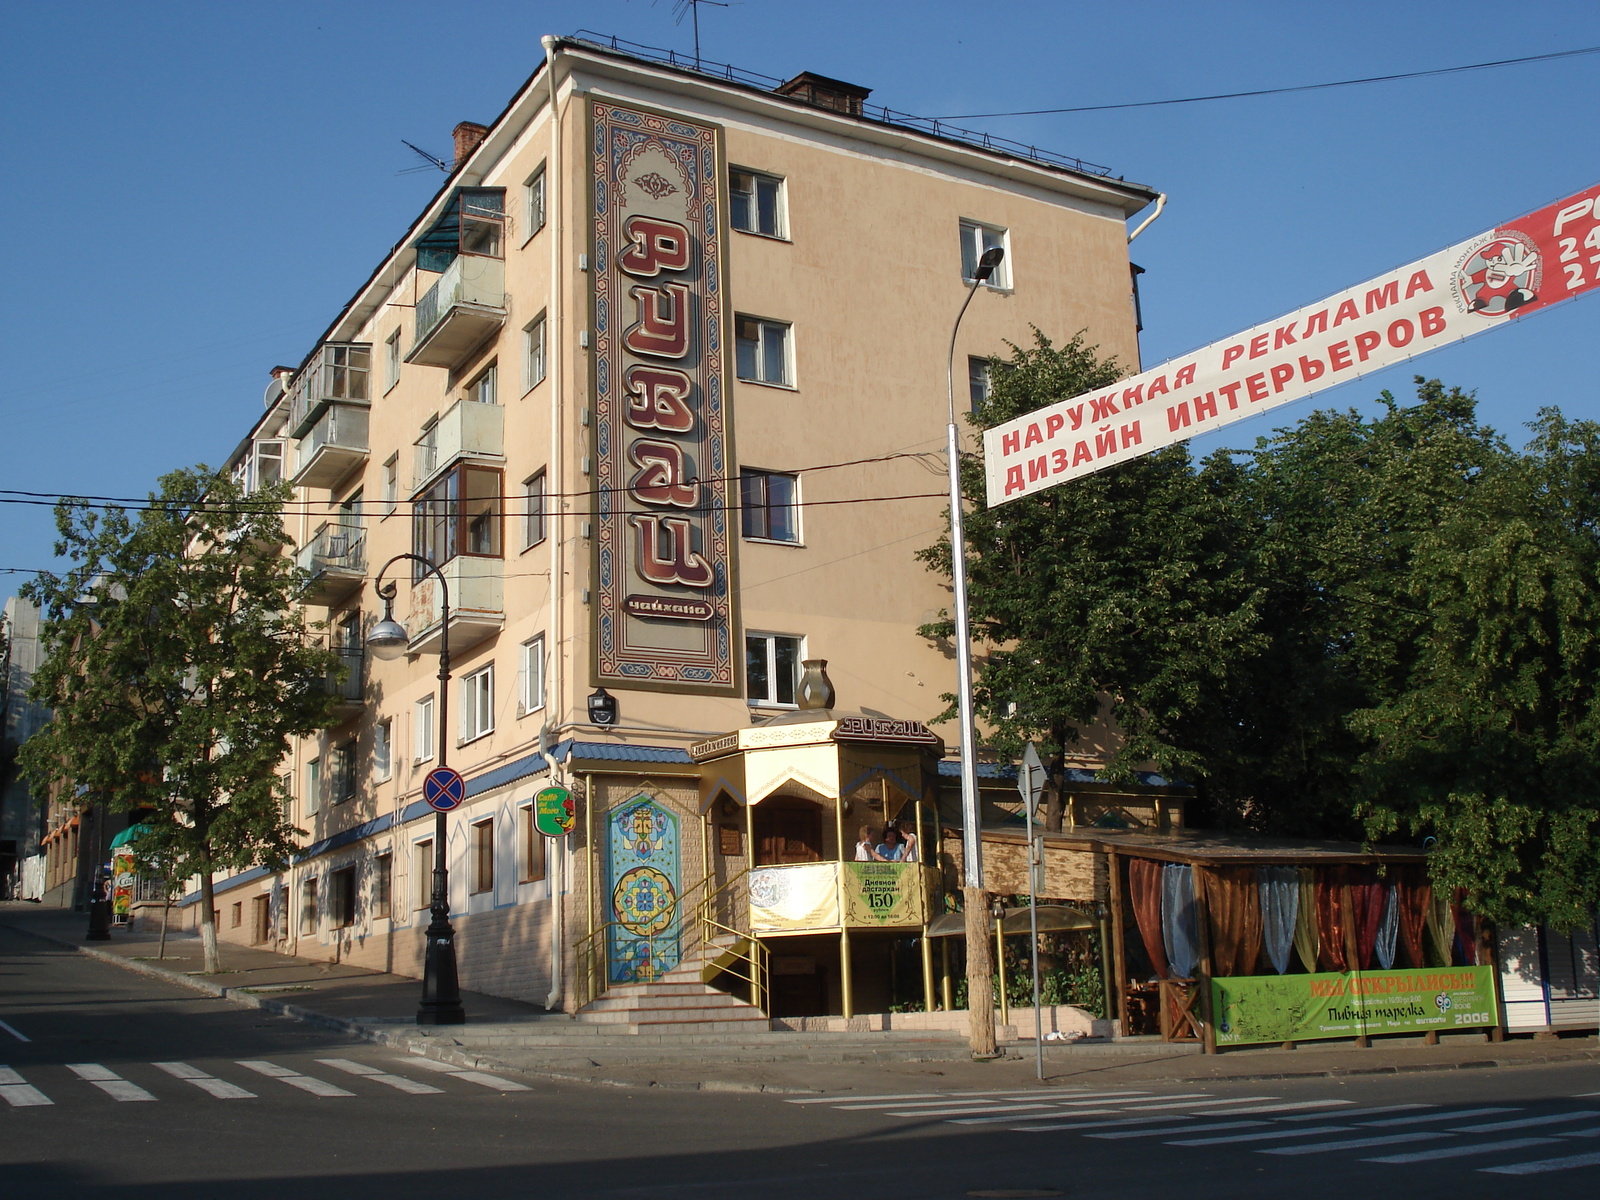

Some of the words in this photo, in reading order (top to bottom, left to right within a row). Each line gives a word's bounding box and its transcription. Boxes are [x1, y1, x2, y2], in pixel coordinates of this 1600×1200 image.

[1454, 236, 1488, 268] МОНТАЖ
[1559, 224, 1600, 263] 24
[1450, 271, 1467, 313] РЕКЛАМА
[1002, 362, 1197, 457] НАРУЖНАЯ
[1221, 268, 1434, 371] РЕКЛАМА
[1004, 420, 1143, 496] ДИЗАЙН
[1166, 306, 1447, 433] ИНТЕРЬЕРОВ
[628, 599, 707, 615] чайхана
[868, 893, 893, 908] 150
[1310, 978, 1345, 998] МЫ
[1349, 972, 1476, 995] ОТКРЫЛИСЬ!!!
[1328, 1005, 1371, 1020] Пивная
[1375, 1002, 1425, 1020] тарелка
[1455, 1013, 1489, 1024] 2006
